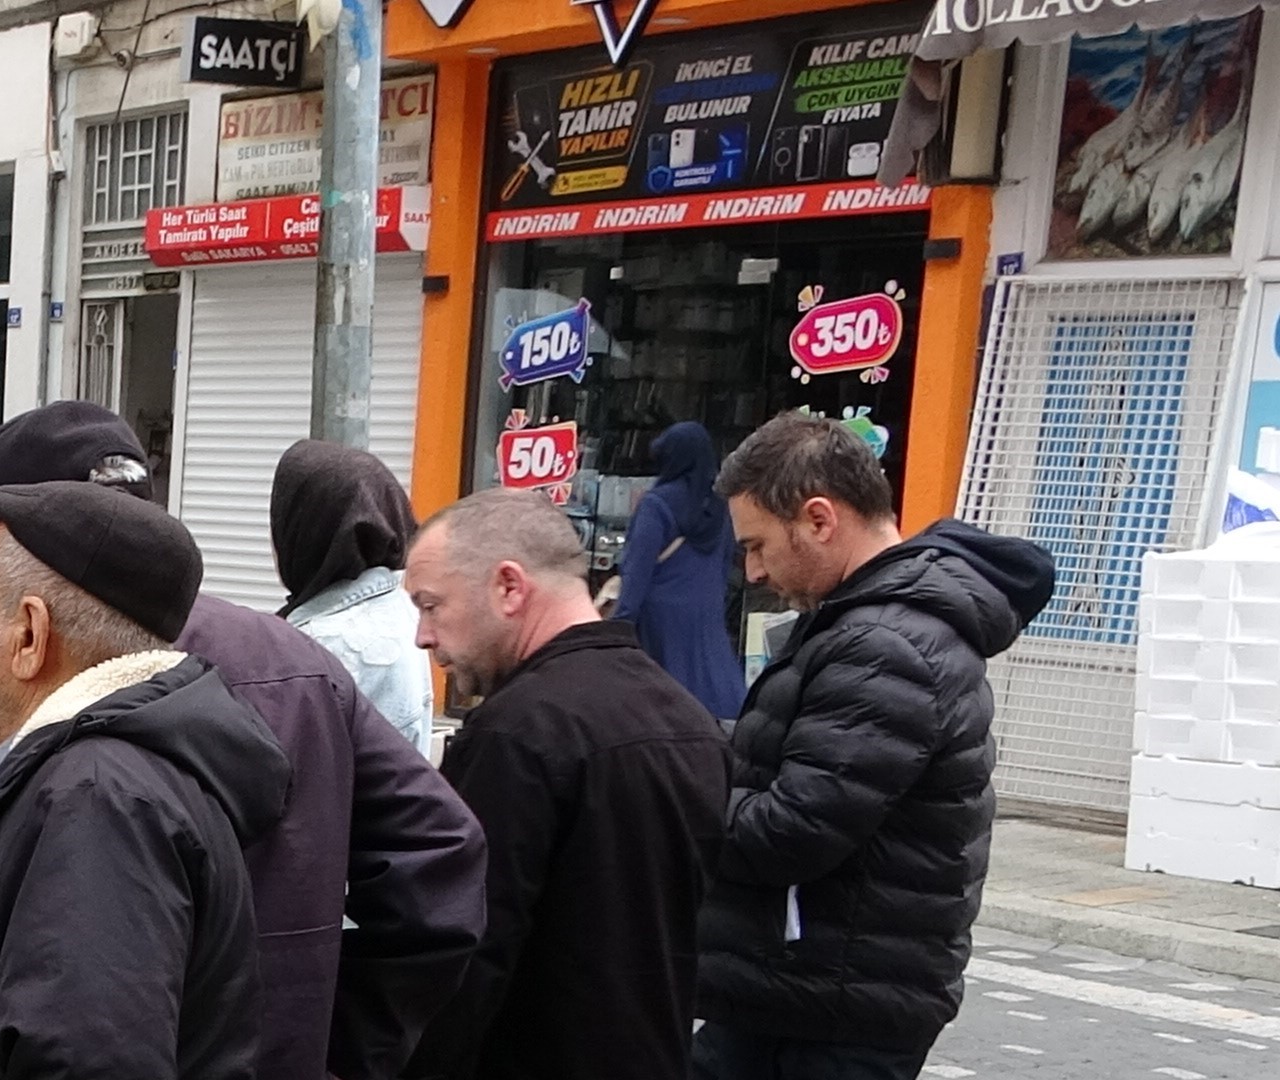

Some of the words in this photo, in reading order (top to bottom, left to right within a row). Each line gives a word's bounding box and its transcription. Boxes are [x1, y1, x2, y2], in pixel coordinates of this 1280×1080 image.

[808, 39, 866, 66] KILIF
[867, 34, 918, 58] CAM
[731, 55, 753, 75] EL
[559, 70, 640, 109] HIZLI
[845, 81, 901, 102] UYGUN
[663, 95, 751, 123] BULUNUR
[560, 128, 630, 157] YAPILIR
[162, 212, 183, 227] Her
[186, 208, 216, 224] Türlü
[218, 206, 248, 221] Saat
[159, 228, 207, 245] Tamiratı
